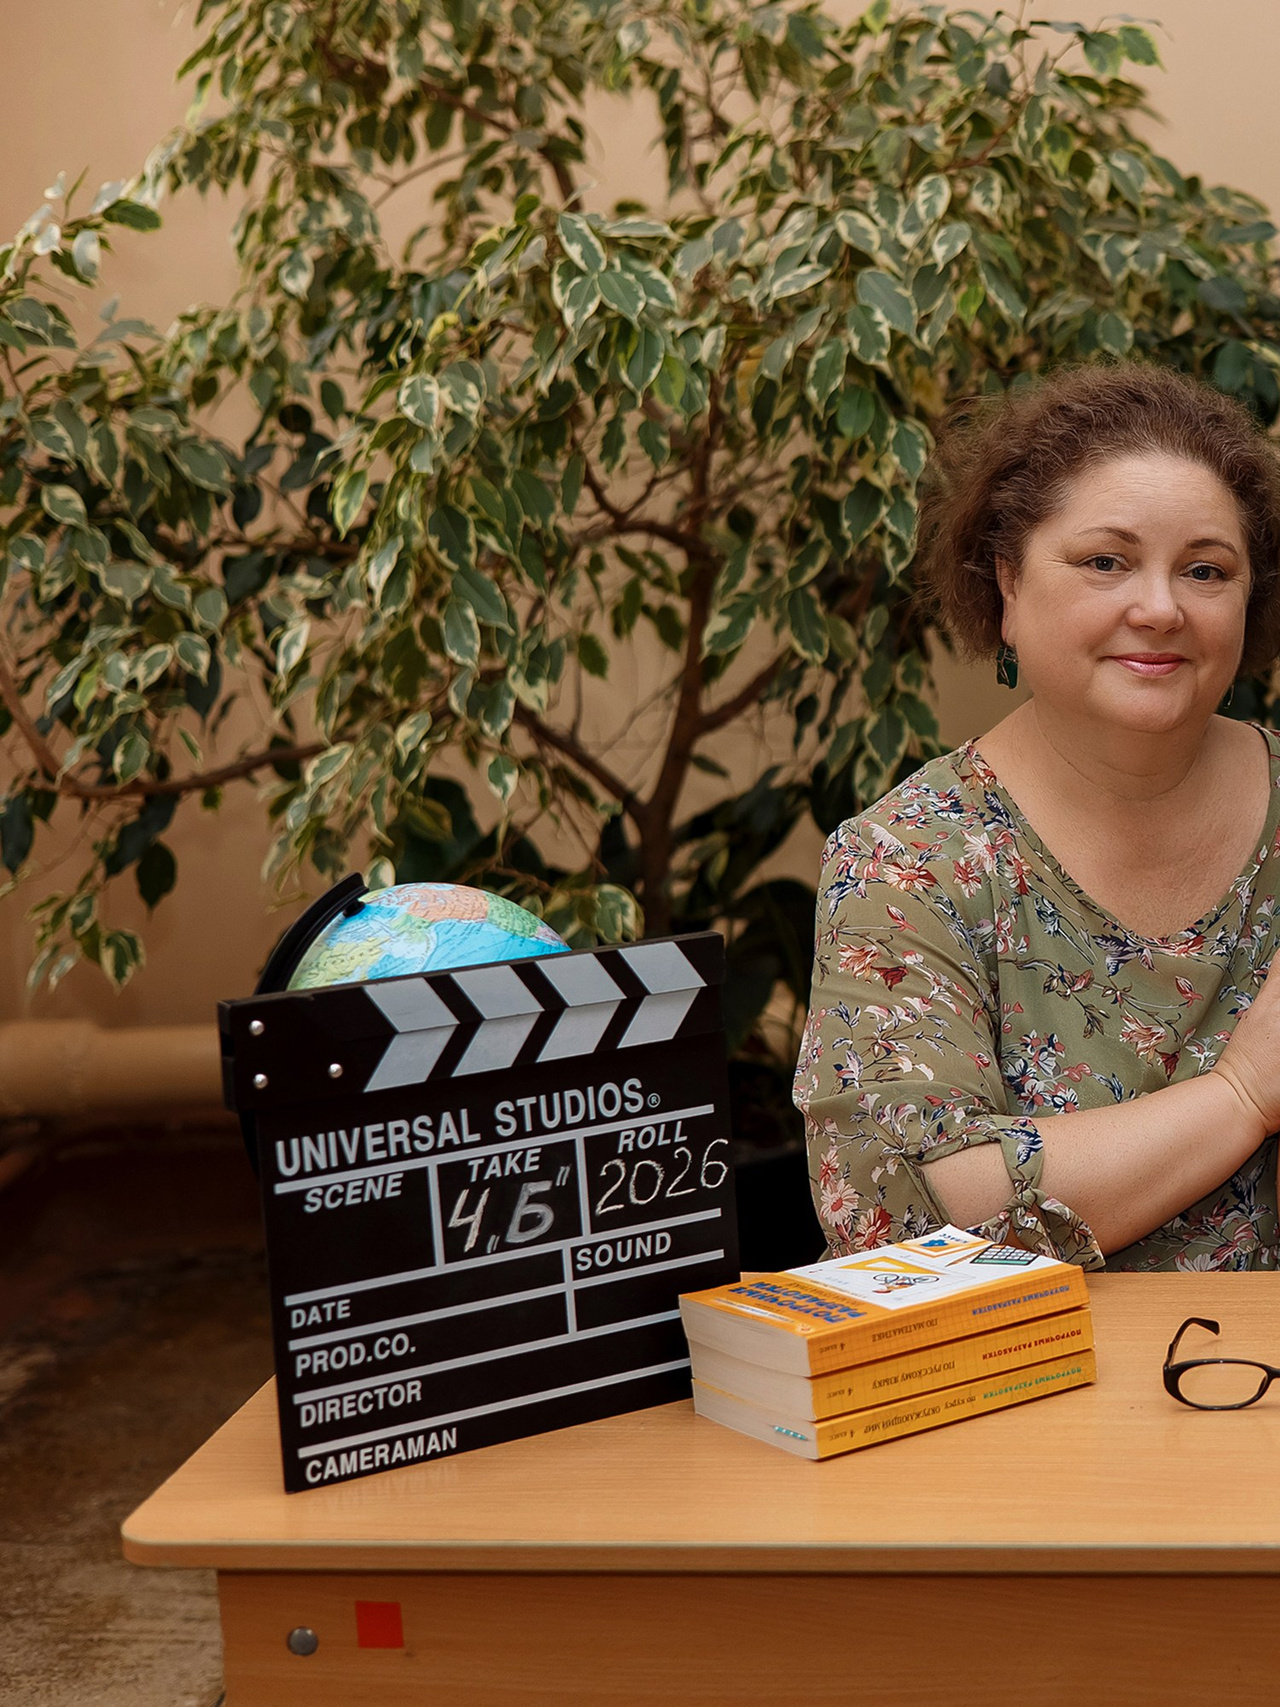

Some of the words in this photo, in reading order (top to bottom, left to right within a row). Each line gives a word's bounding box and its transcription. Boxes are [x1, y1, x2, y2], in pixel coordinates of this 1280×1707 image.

[275, 1108, 481, 1177] UNIVERSAL
[617, 1121, 687, 1153] ROLL
[468, 1148, 542, 1182] TAKE
[595, 1138, 729, 1216] 2026
[303, 1173, 404, 1213] SCENE
[576, 1232, 672, 1271] SOUND
[728, 1286, 847, 1323] ПОУРОЧНЫЕ
[749, 1281, 868, 1318] РАЗРАБОТКИ
[1023, 1285, 1070, 1302] ПОУРОЧНЫЕ
[291, 1299, 350, 1329] DATE
[972, 1297, 1021, 1316] РАЗРАБОТКИ
[872, 1320, 925, 1342] МАТЕМАТИКЕ
[927, 1318, 938, 1328] ПО
[1034, 1328, 1082, 1347] ПОУРОЧНЫЕ
[296, 1333, 416, 1378] PROD.CO.
[982, 1341, 1032, 1360] РАЗРАБОТКИ
[900, 1363, 942, 1382] РУССКОМУ
[943, 1360, 956, 1370] ПО
[1034, 1367, 1082, 1385] ПОУРОЧНЫЕ
[872, 1375, 899, 1390] ЯЗЫКУ
[983, 1380, 1033, 1399] РАЗРАБОТКИ
[300, 1380, 422, 1428] DIRECTOR
[864, 1422, 881, 1434] МИР
[882, 1405, 941, 1430] ОКРУЖАЮЩИЙ
[305, 1427, 457, 1484] CAMERAMAN
